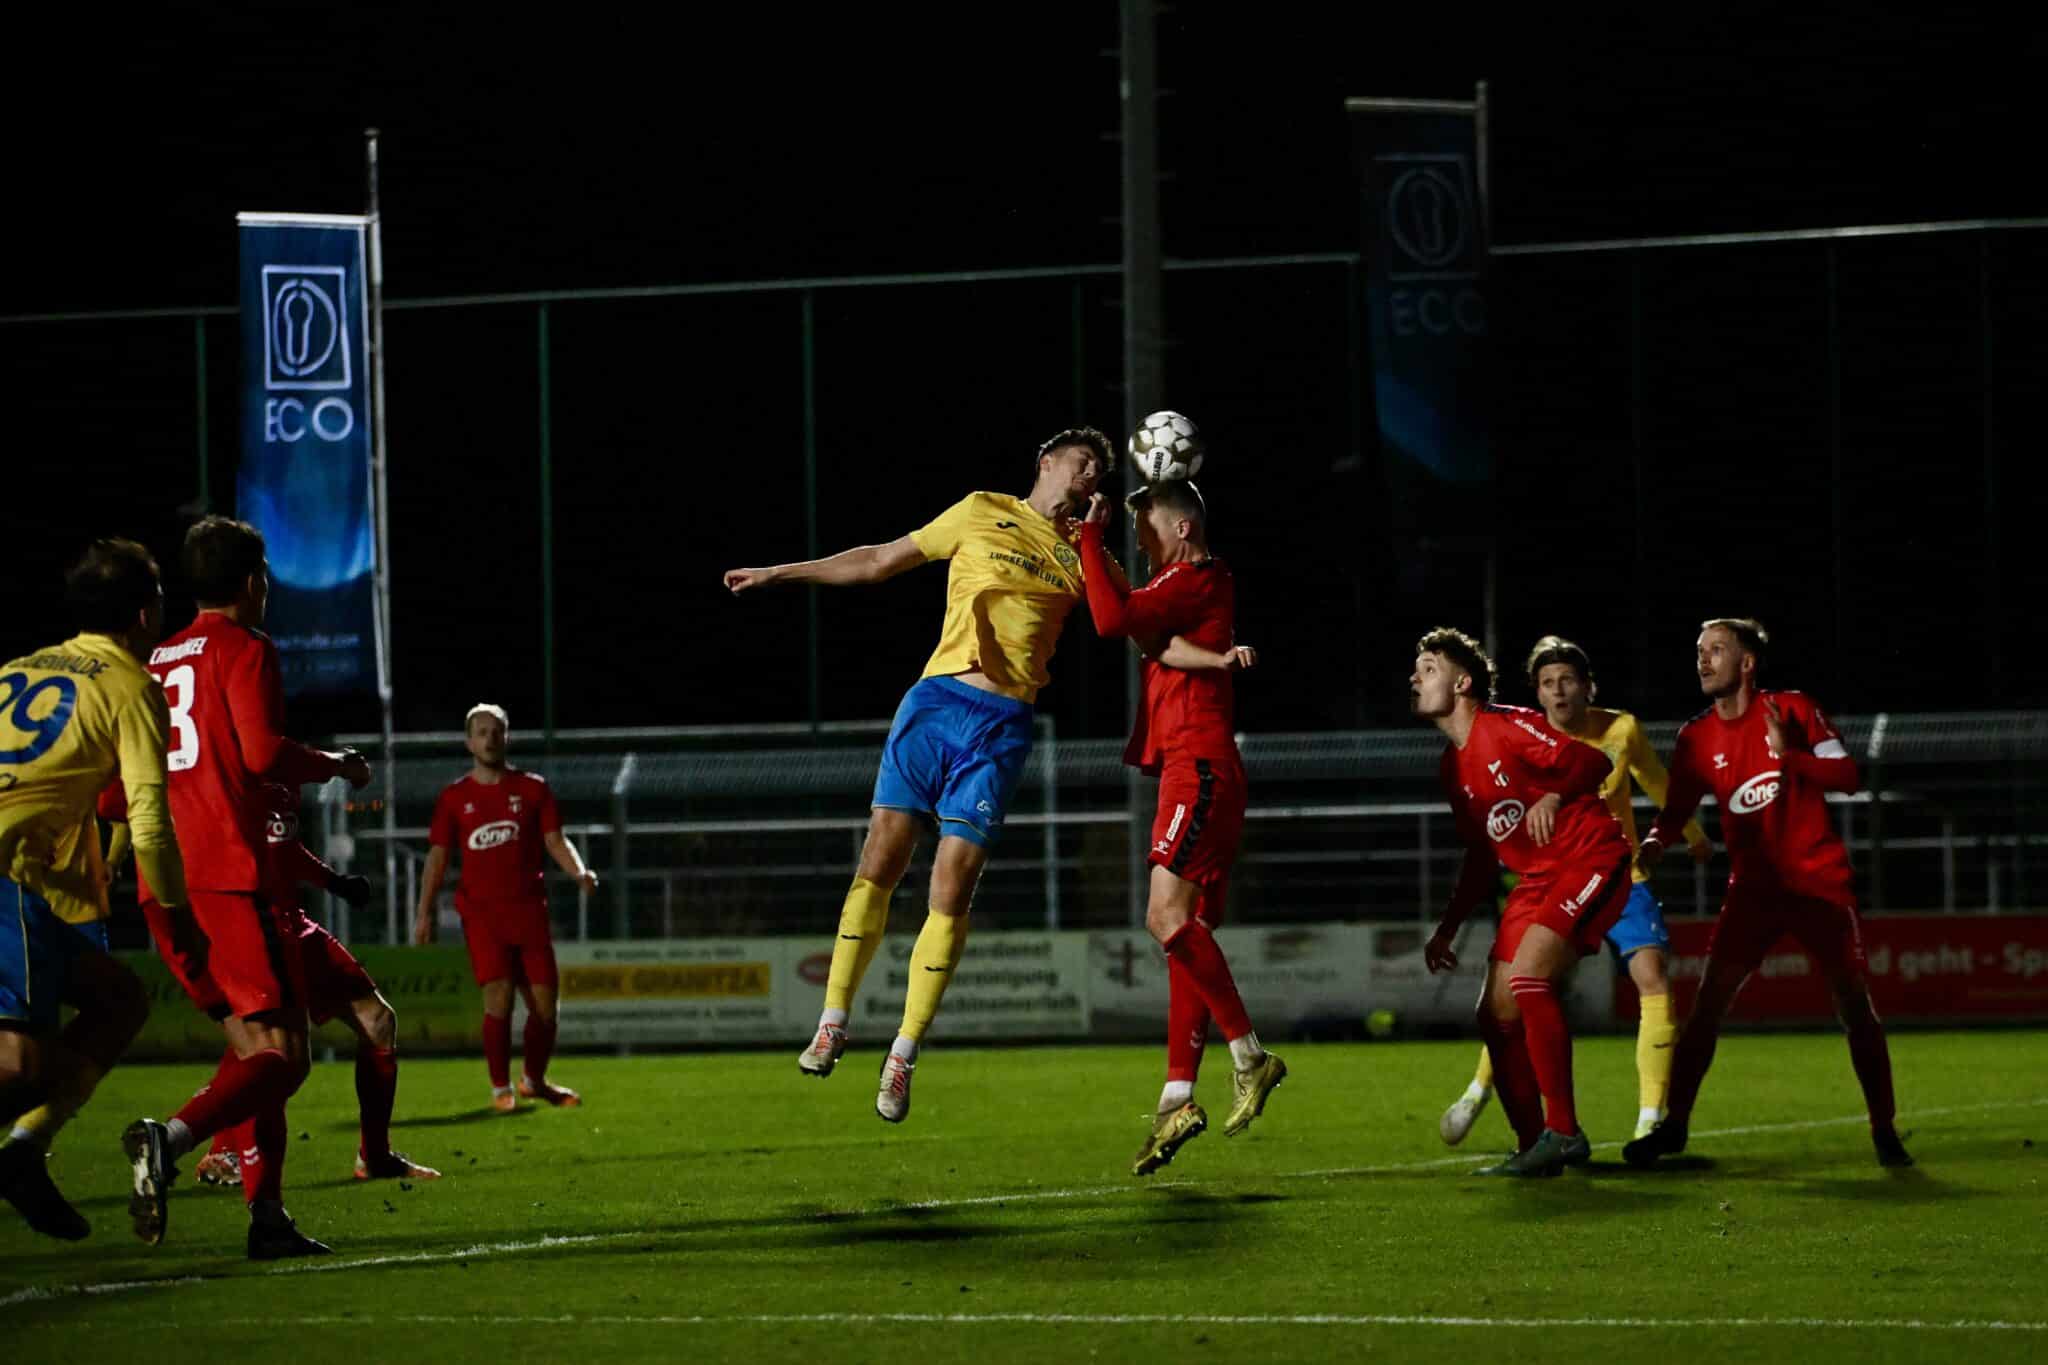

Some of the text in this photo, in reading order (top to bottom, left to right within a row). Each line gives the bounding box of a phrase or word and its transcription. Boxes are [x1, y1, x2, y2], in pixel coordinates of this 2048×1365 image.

[264, 396, 355, 443] ECO
[150, 664, 200, 772] 3
[1898, 943, 1976, 982] geht
